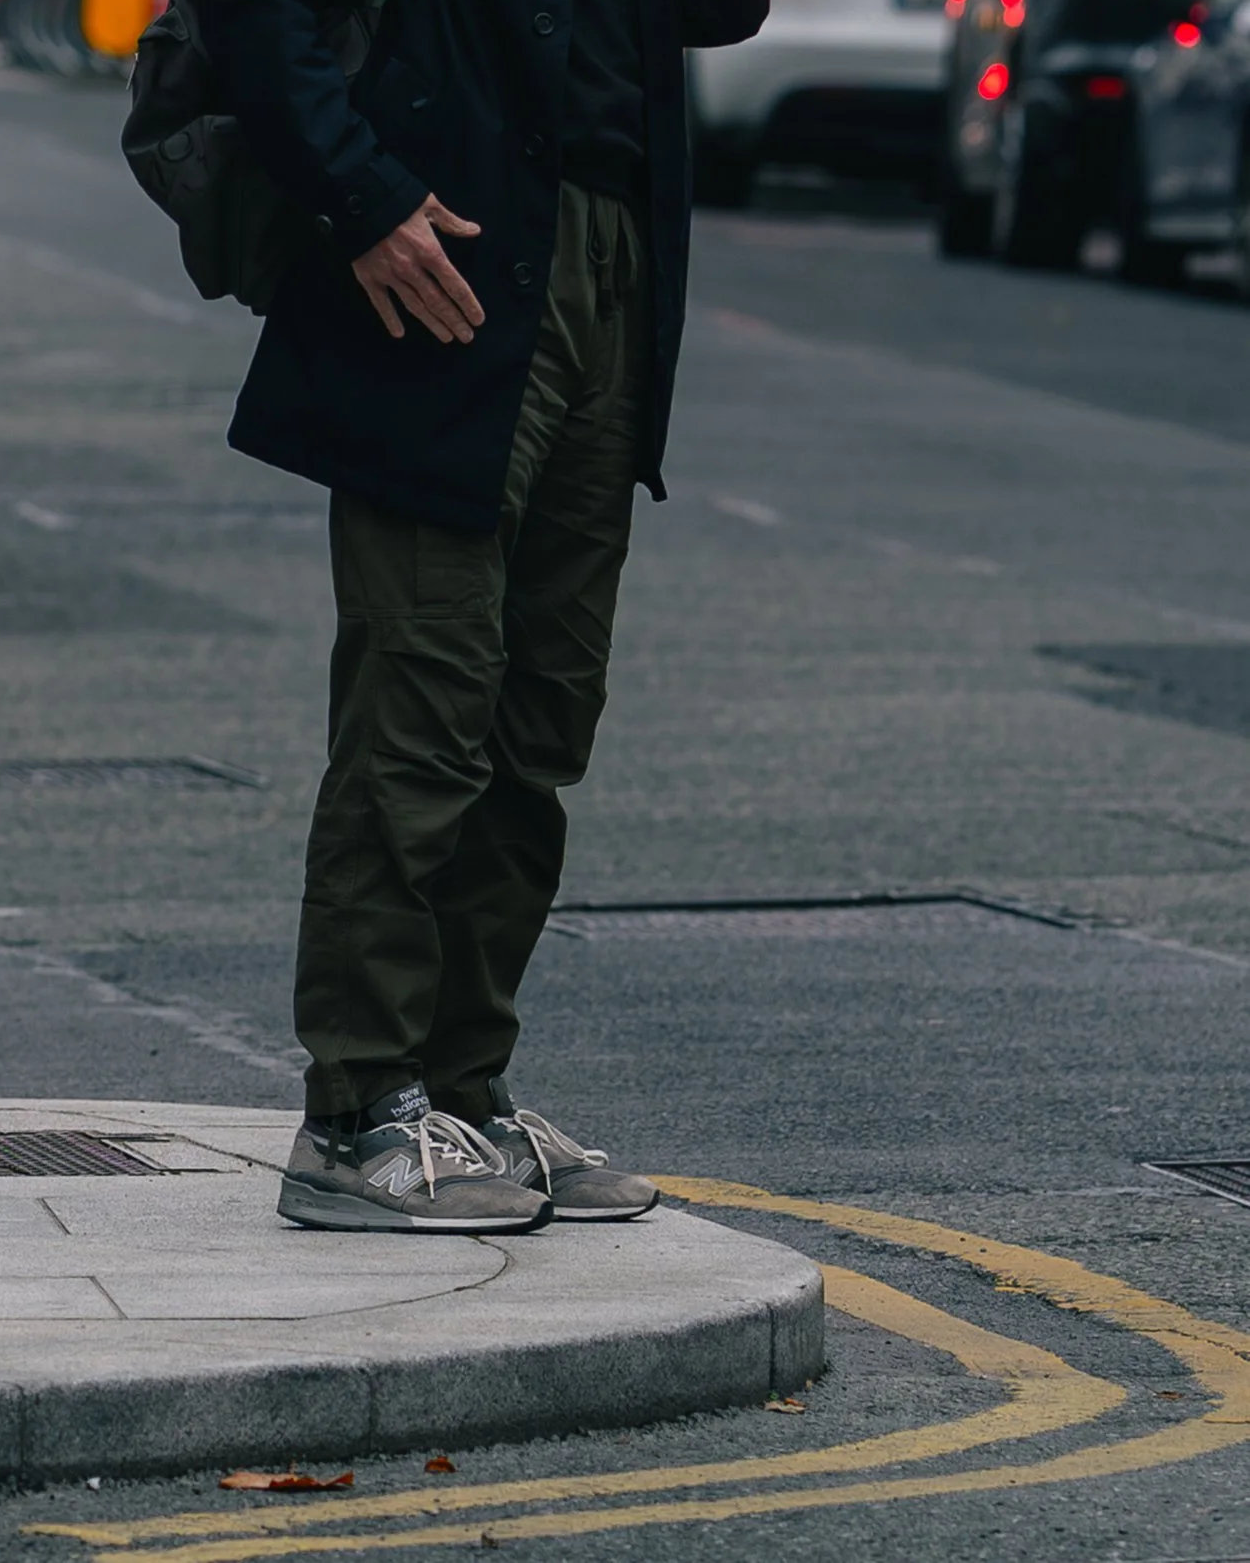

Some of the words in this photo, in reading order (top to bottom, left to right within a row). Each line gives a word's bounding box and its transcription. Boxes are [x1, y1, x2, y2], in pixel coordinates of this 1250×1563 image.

[398, 1086, 420, 1103] new
[390, 1096, 430, 1118] balanc
[367, 1153, 425, 1197] N
